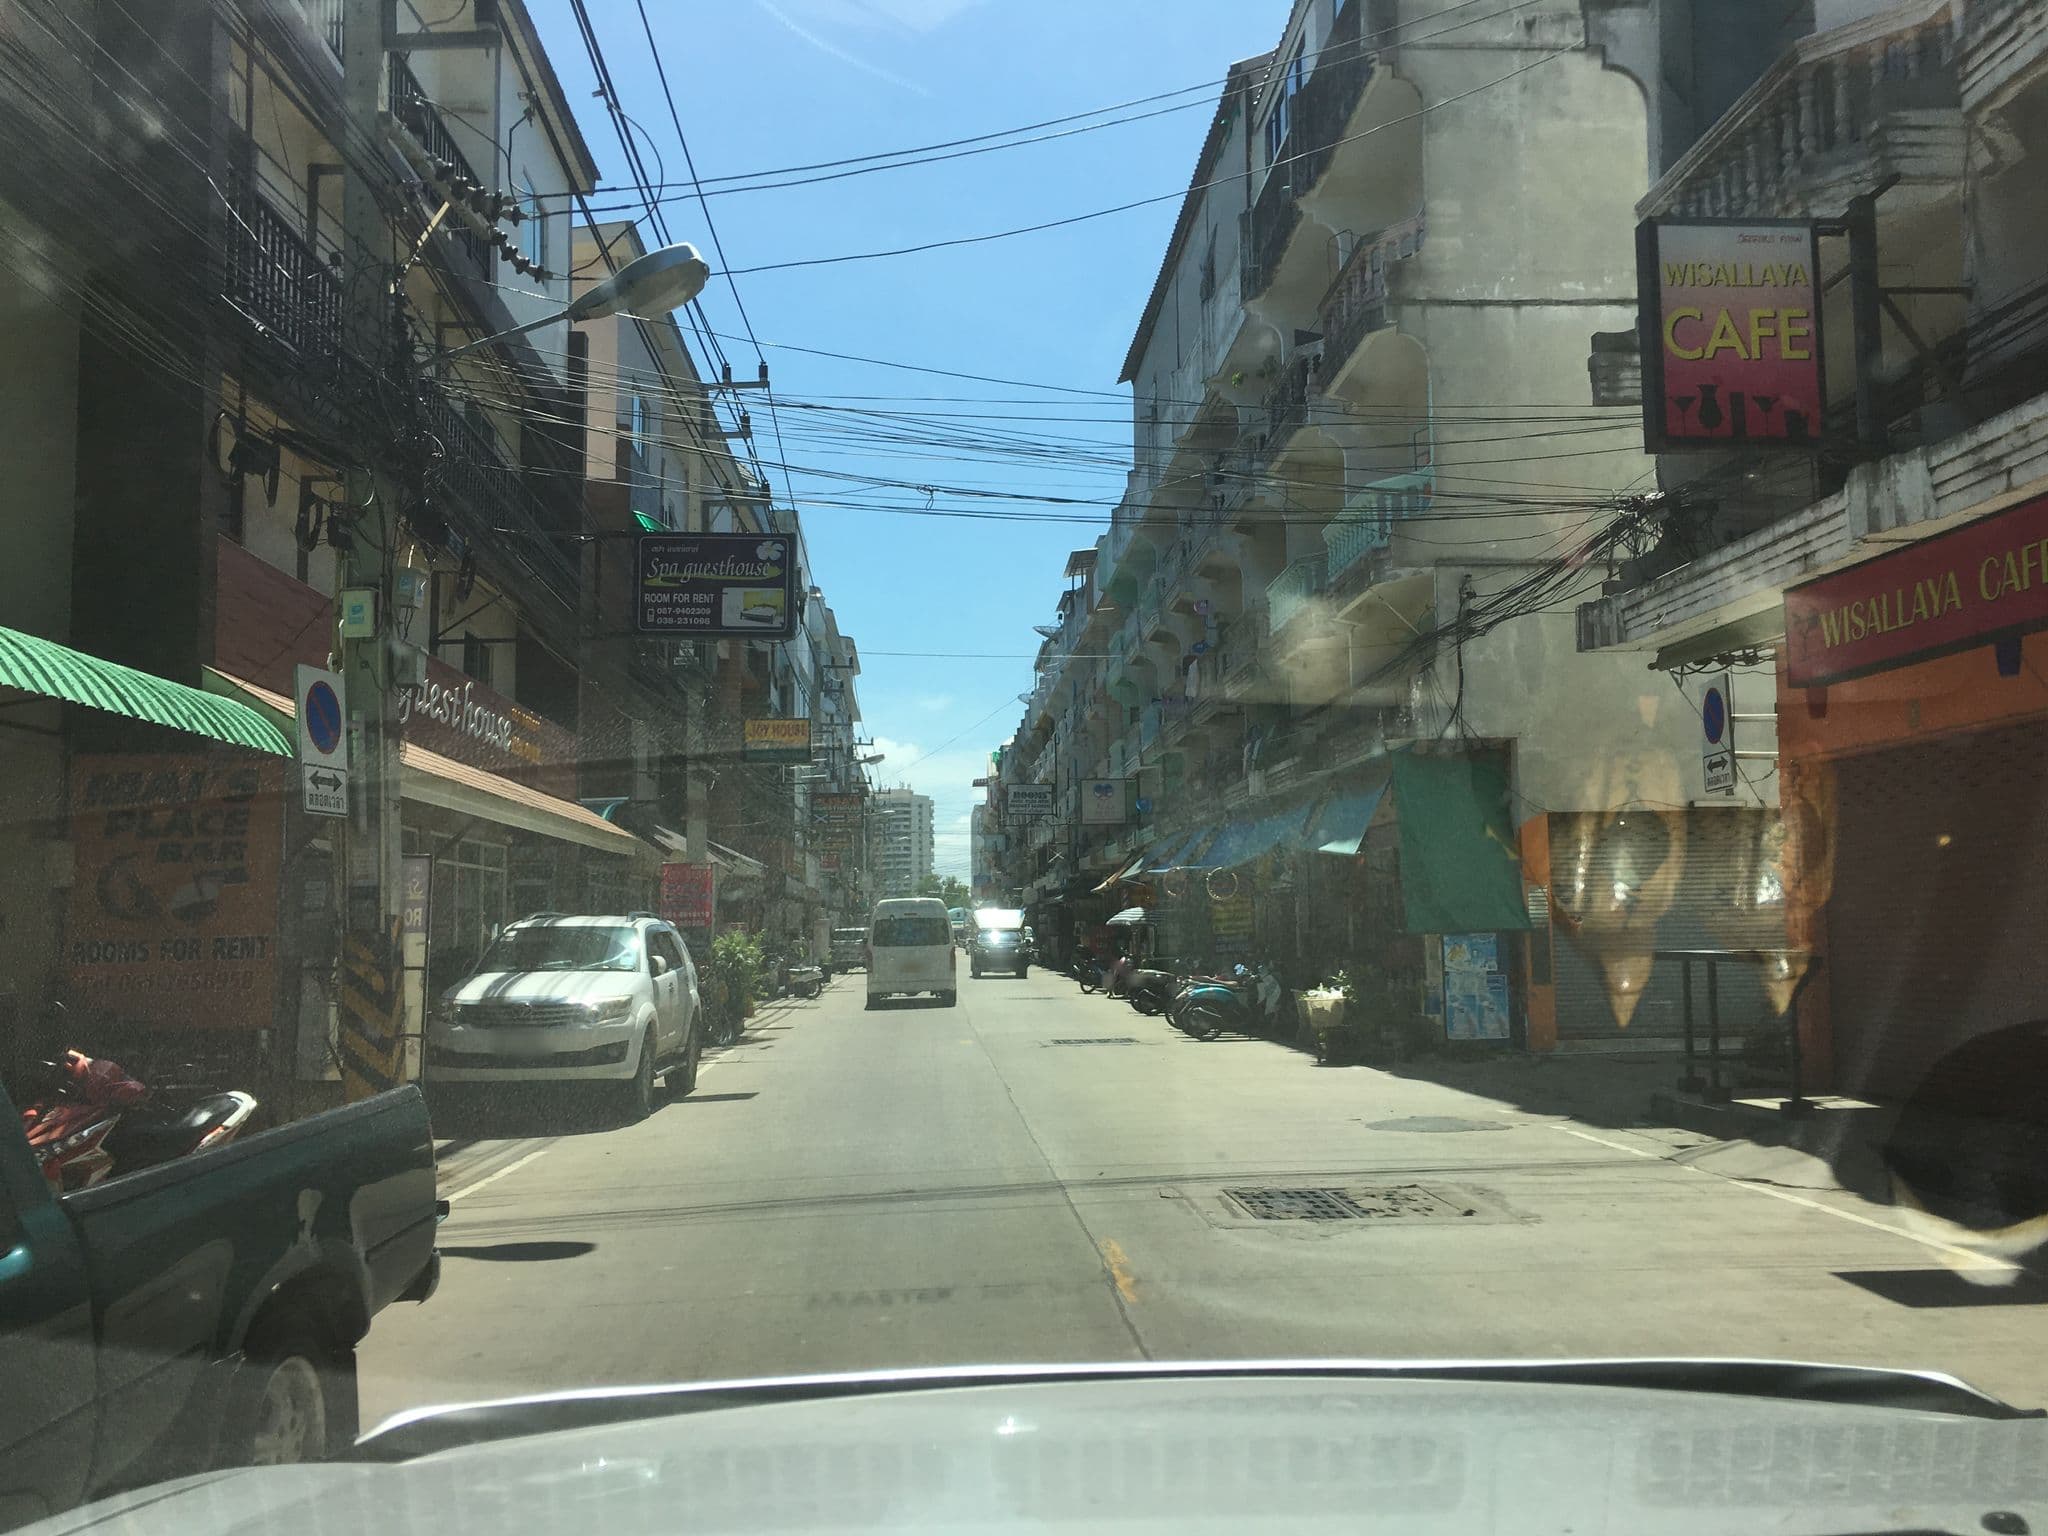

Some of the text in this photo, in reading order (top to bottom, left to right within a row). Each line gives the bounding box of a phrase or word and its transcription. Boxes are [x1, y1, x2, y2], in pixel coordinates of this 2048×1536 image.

[1664, 262, 1808, 287] WISALLAYA
[1664, 306, 1811, 360] CAFE
[647, 555, 770, 583] Spa guesthouse
[644, 593, 715, 603] ROOM FOR RENT
[1819, 569, 1962, 648] WISALLAYA
[309, 793, 344, 809] ตลอดเวลา
[104, 808, 250, 840] PLACE
[73, 936, 269, 965] ROOMS FOR RENT
